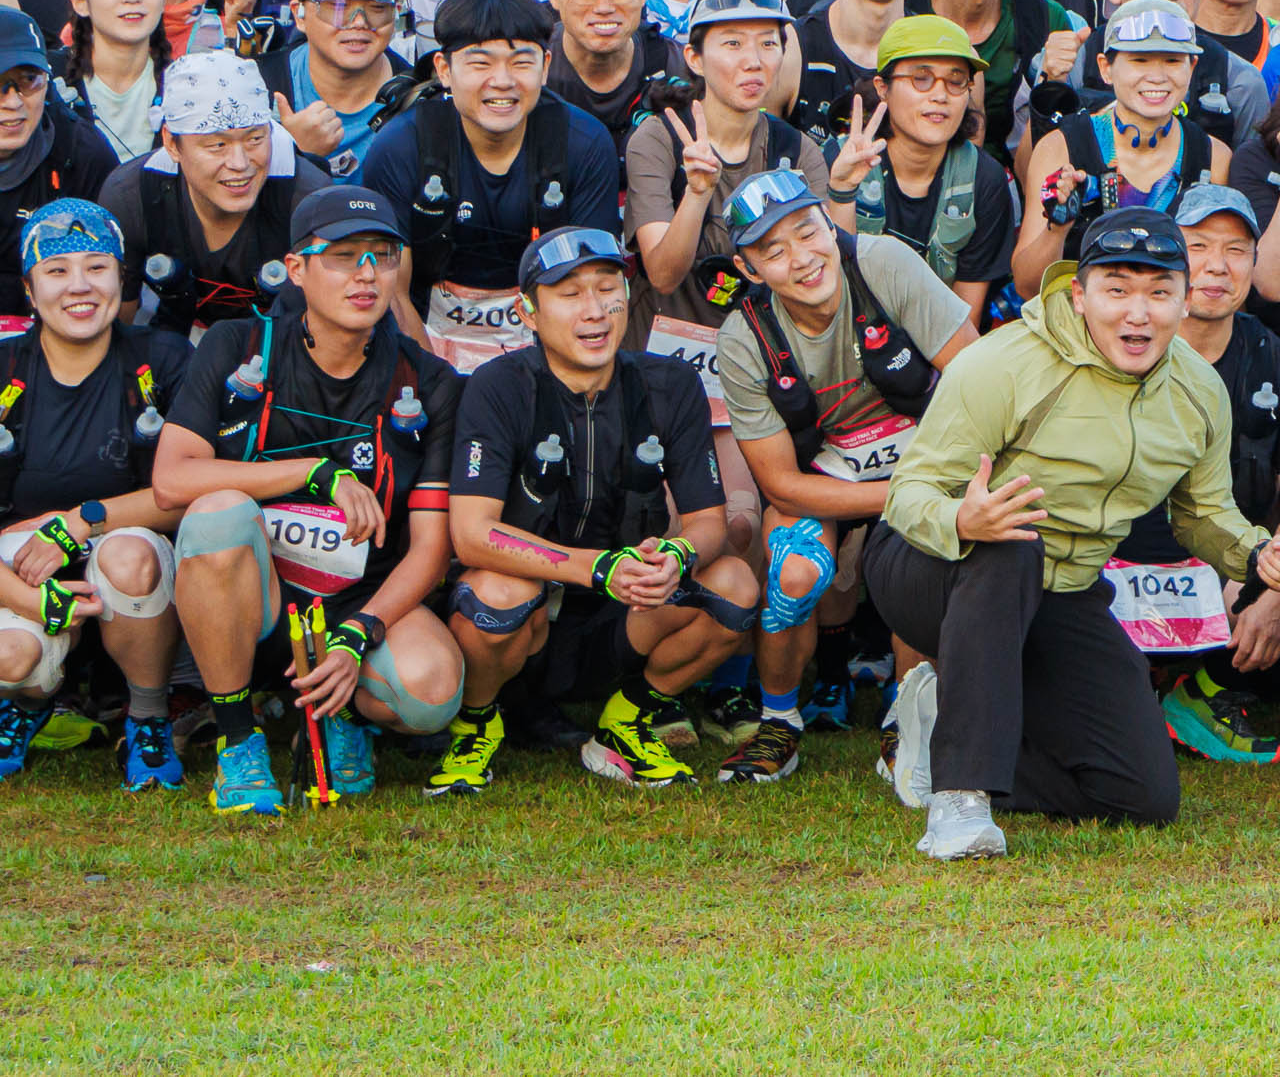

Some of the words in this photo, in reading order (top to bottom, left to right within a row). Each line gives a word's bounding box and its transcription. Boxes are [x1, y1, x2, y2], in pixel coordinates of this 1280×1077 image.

[349, 200, 377, 212] GORE
[446, 303, 522, 328] 4206
[468, 440, 482, 478] HOKA
[50, 524, 77, 552] LEKI
[270, 518, 342, 552] 1019
[1127, 573, 1198, 601] 1042
